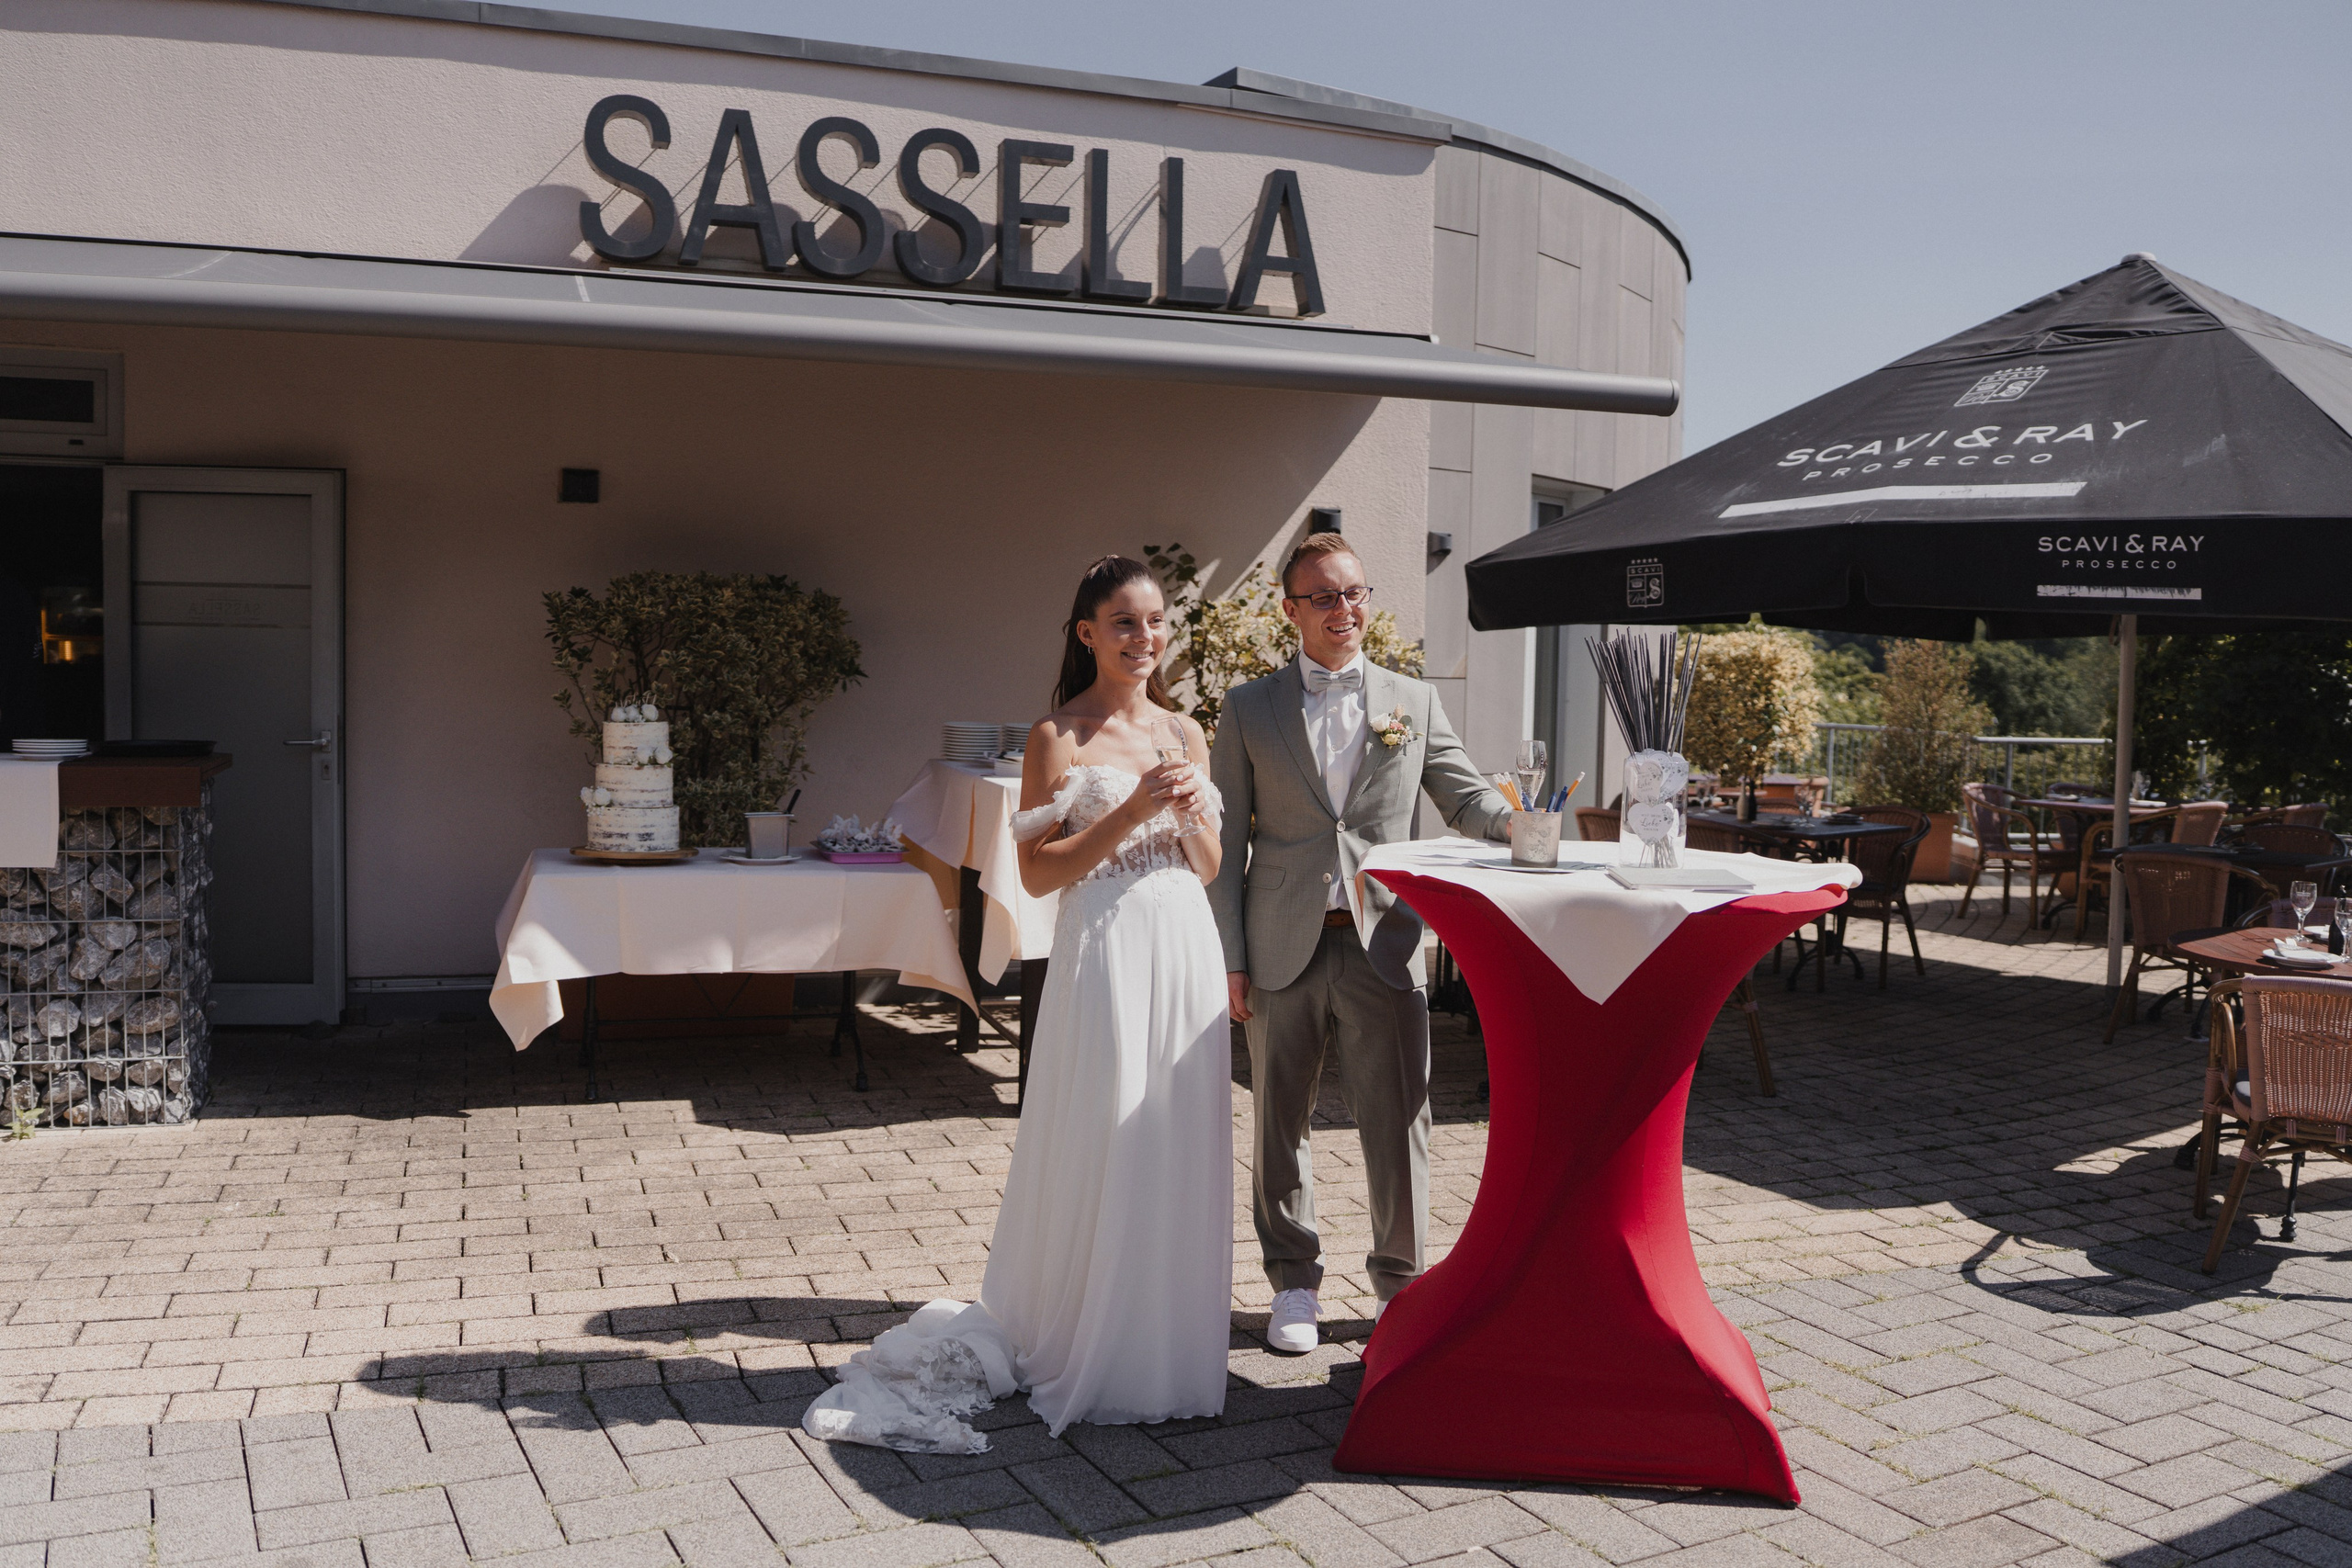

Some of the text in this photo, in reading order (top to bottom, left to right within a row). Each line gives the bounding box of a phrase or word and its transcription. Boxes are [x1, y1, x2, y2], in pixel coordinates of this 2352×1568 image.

[579, 94, 1325, 318] SASSELLA
[1777, 419, 2148, 467] SCAVI & RAY
[1802, 453, 2052, 480] PROSECCO
[2038, 534, 2205, 554] SCAVI & RAY
[2062, 559, 2177, 570] PROSECCO
